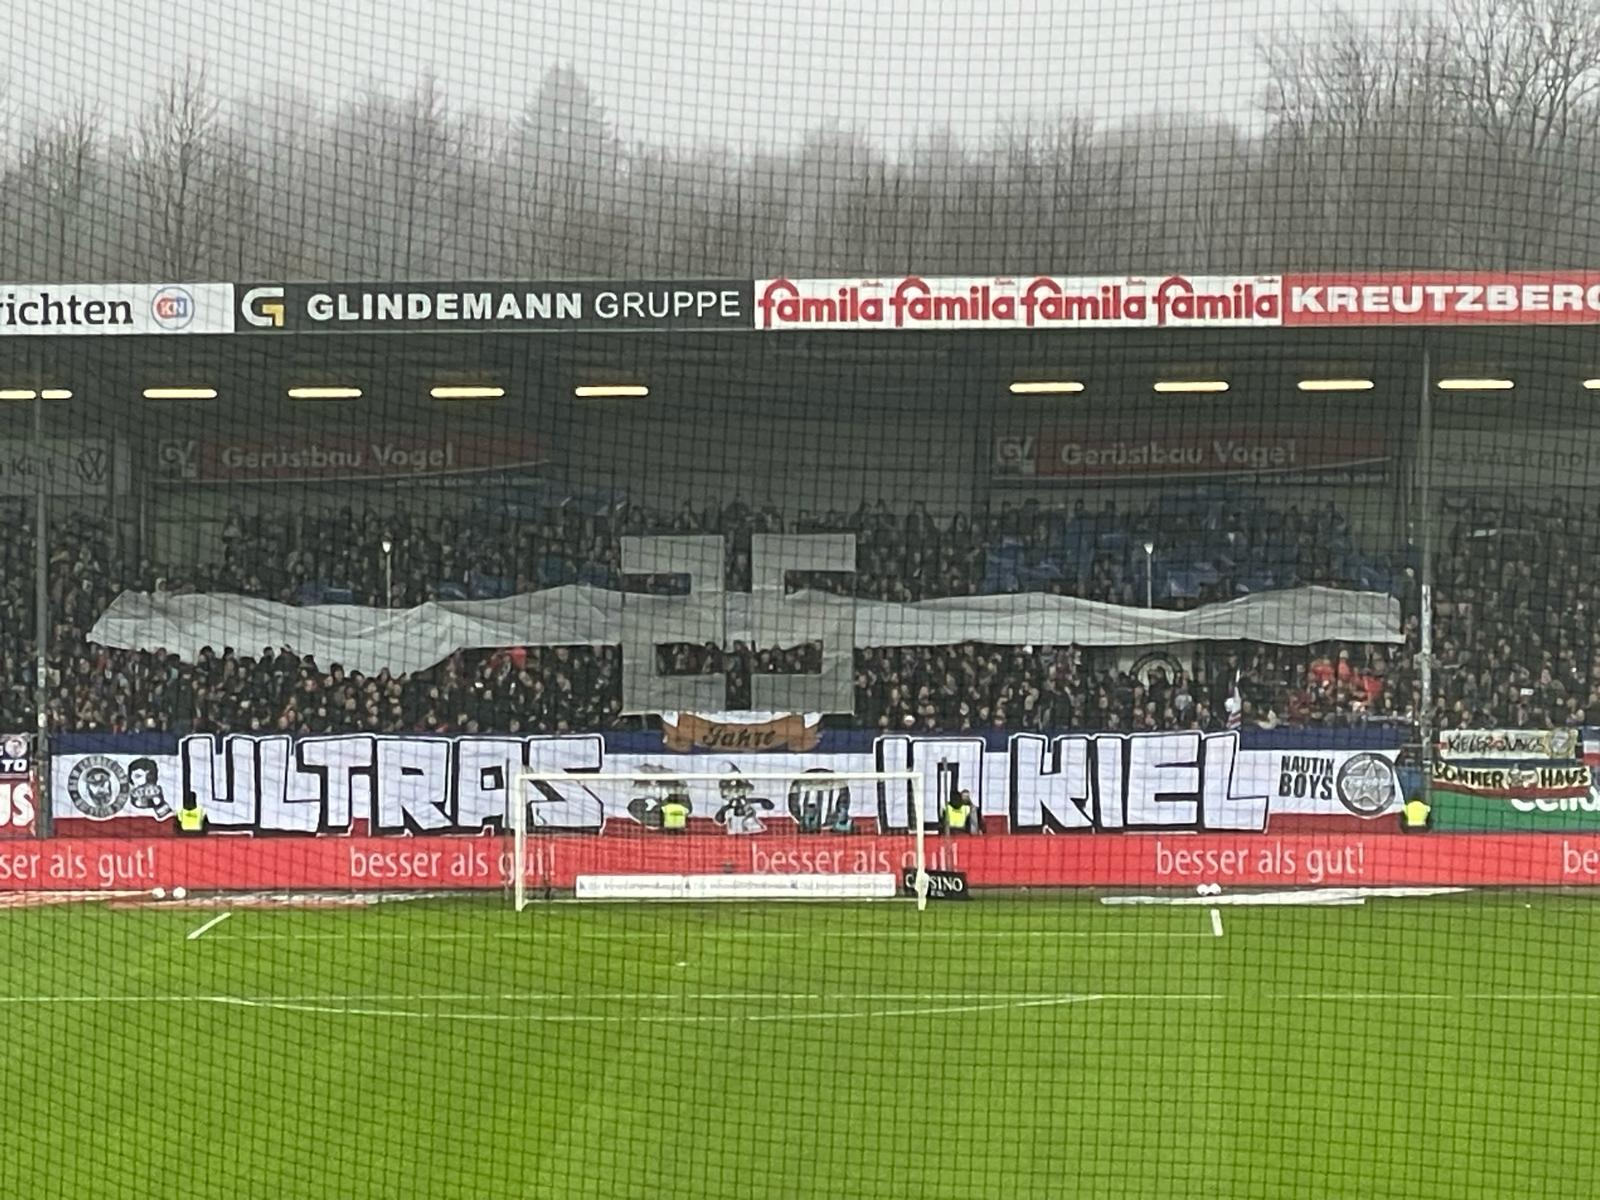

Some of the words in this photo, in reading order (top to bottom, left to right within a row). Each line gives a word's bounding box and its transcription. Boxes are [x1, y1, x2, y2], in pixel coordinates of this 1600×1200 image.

[307, 292, 582, 321] GLINDEMANN
[595, 290, 741, 319] GRUPPE
[758, 278, 883, 327] famila
[890, 275, 1014, 326] famila
[1021, 275, 1146, 325] famila
[1153, 276, 1279, 324] famila
[371, 443, 451, 470] Vogel
[1061, 440, 1203, 467] Gerüstbau
[1213, 439, 1297, 467] Vogel
[2, 759, 27, 771] TO
[1541, 768, 1588, 787] HAUS
[179, 733, 605, 837] ULTRAS
[1009, 731, 1269, 834] KIEL
[1279, 773, 1333, 801] BOYS
[50, 845, 87, 880] als
[98, 847, 156, 888] gut!
[351, 846, 442, 878] besser
[451, 843, 489, 877] als
[751, 843, 844, 874] besser
[853, 842, 890, 874] als
[1156, 841, 1249, 876] besser
[1258, 841, 1296, 875] als
[1306, 841, 1364, 884] gut!
[905, 873, 964, 893] CSINO
